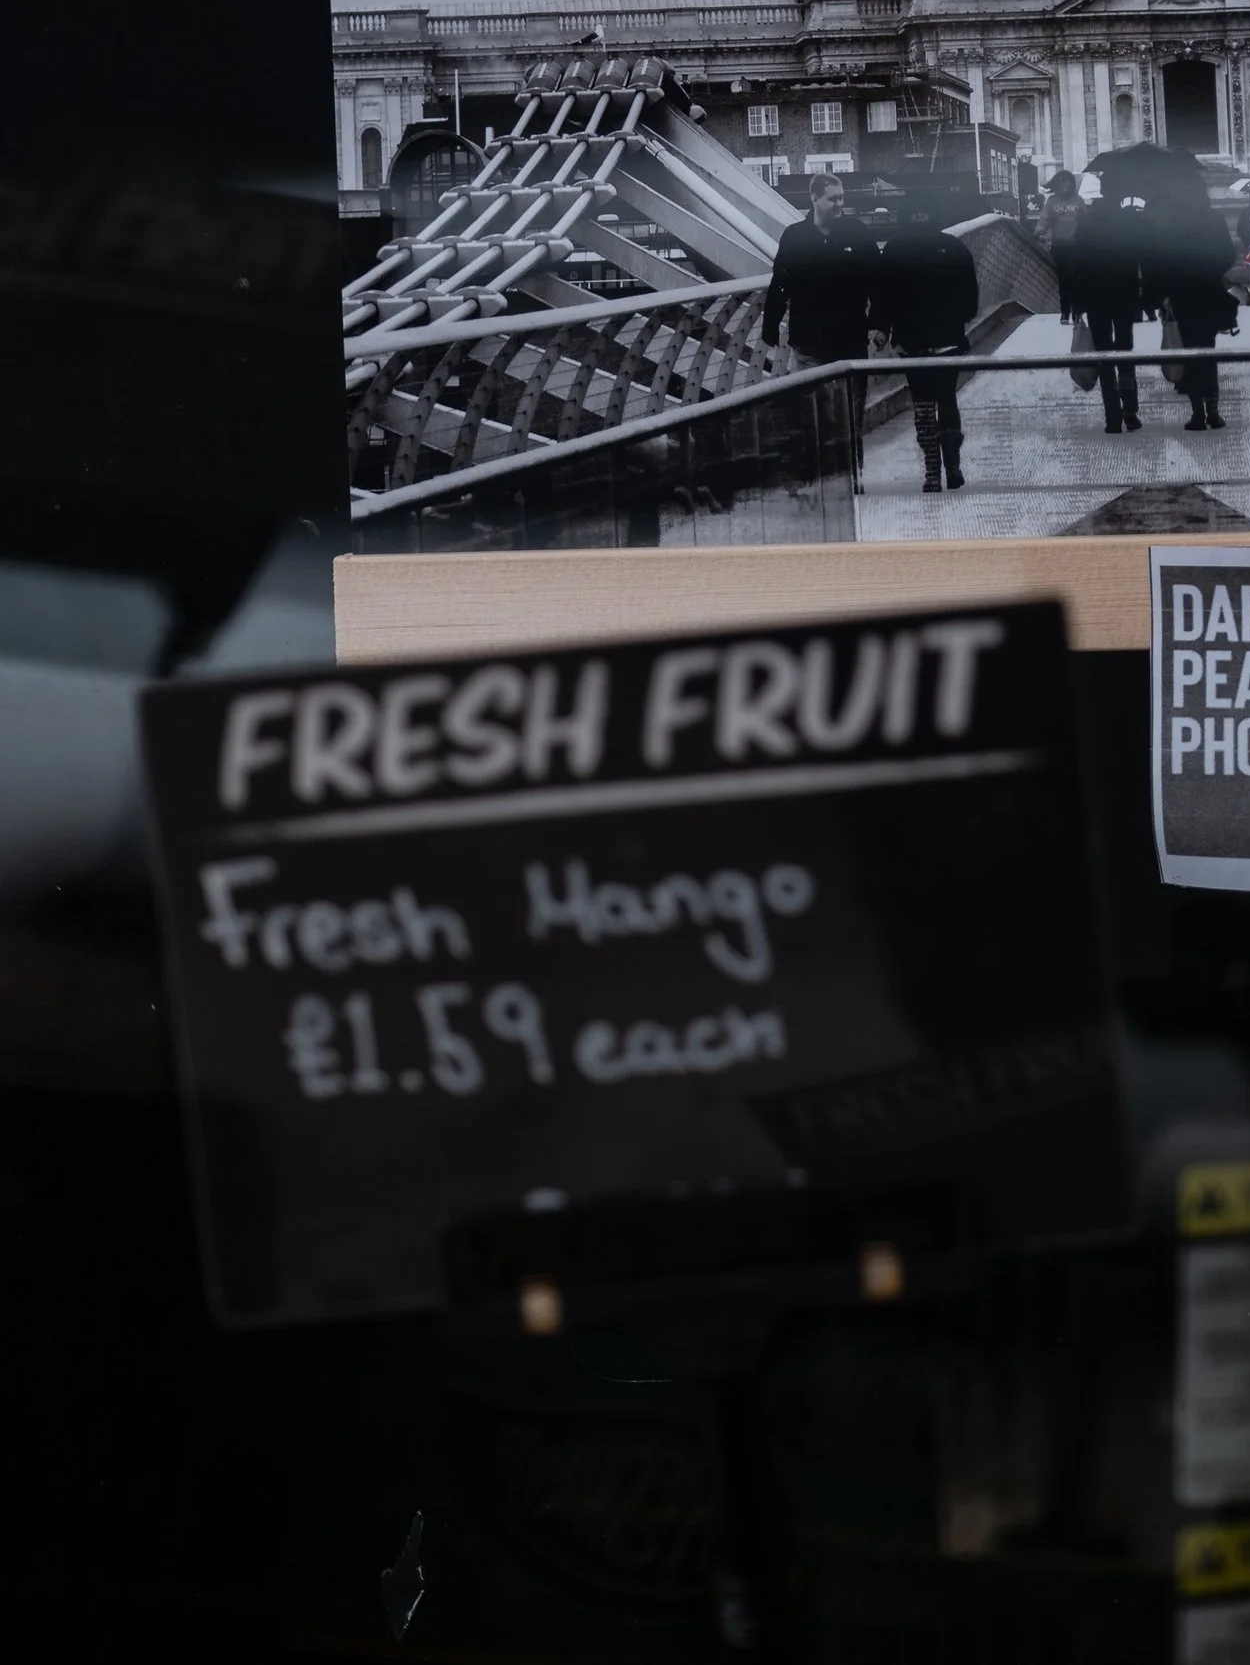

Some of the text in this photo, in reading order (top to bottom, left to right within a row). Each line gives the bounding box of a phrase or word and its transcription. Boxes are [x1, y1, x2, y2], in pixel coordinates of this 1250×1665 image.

[218, 617, 1005, 810] FRESH FRUIT
[196, 855, 815, 984] Fresh Mango
[285, 982, 787, 1100] £1.59 each
